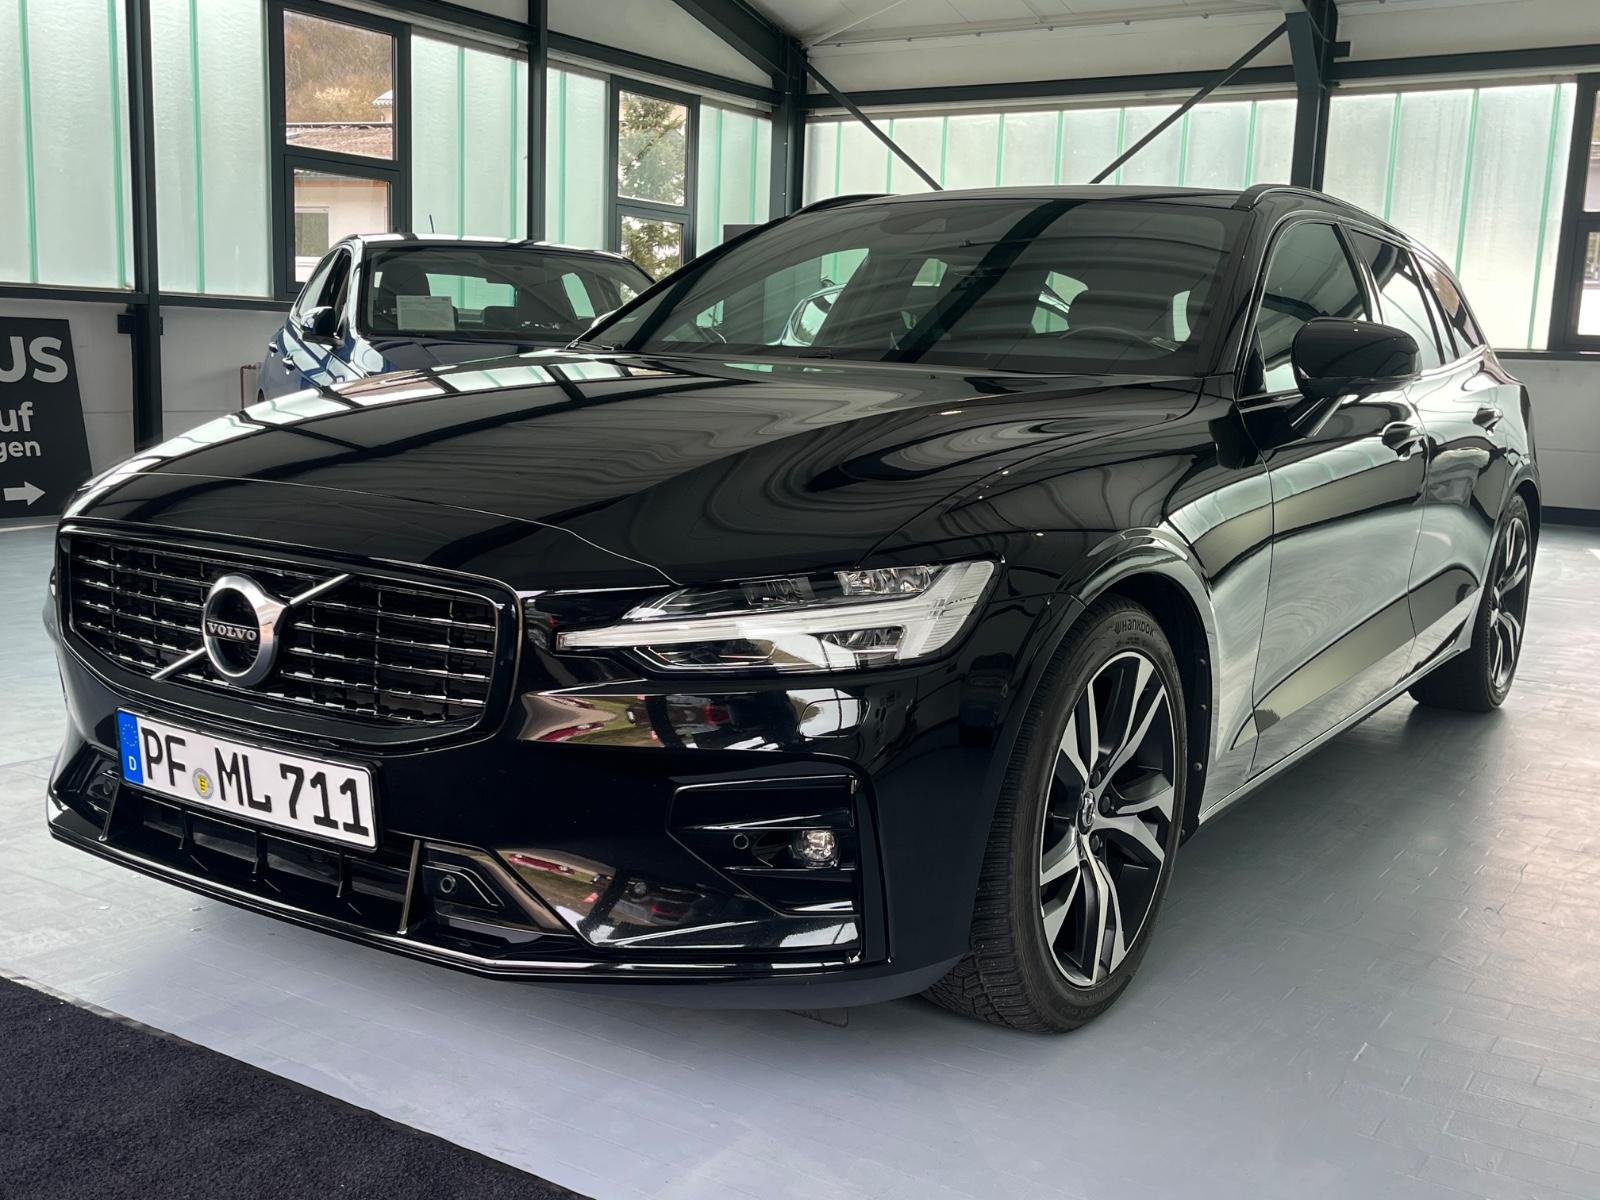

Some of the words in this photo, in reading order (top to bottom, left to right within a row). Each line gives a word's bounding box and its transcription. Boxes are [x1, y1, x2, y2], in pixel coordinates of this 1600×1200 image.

[0, 336, 68, 383] US
[0, 401, 33, 432] uf
[207, 622, 257, 640] VOLVO
[128, 756, 137, 771] D
[141, 727, 186, 787] PF
[215, 747, 272, 813] ML
[279, 763, 369, 836] 711
